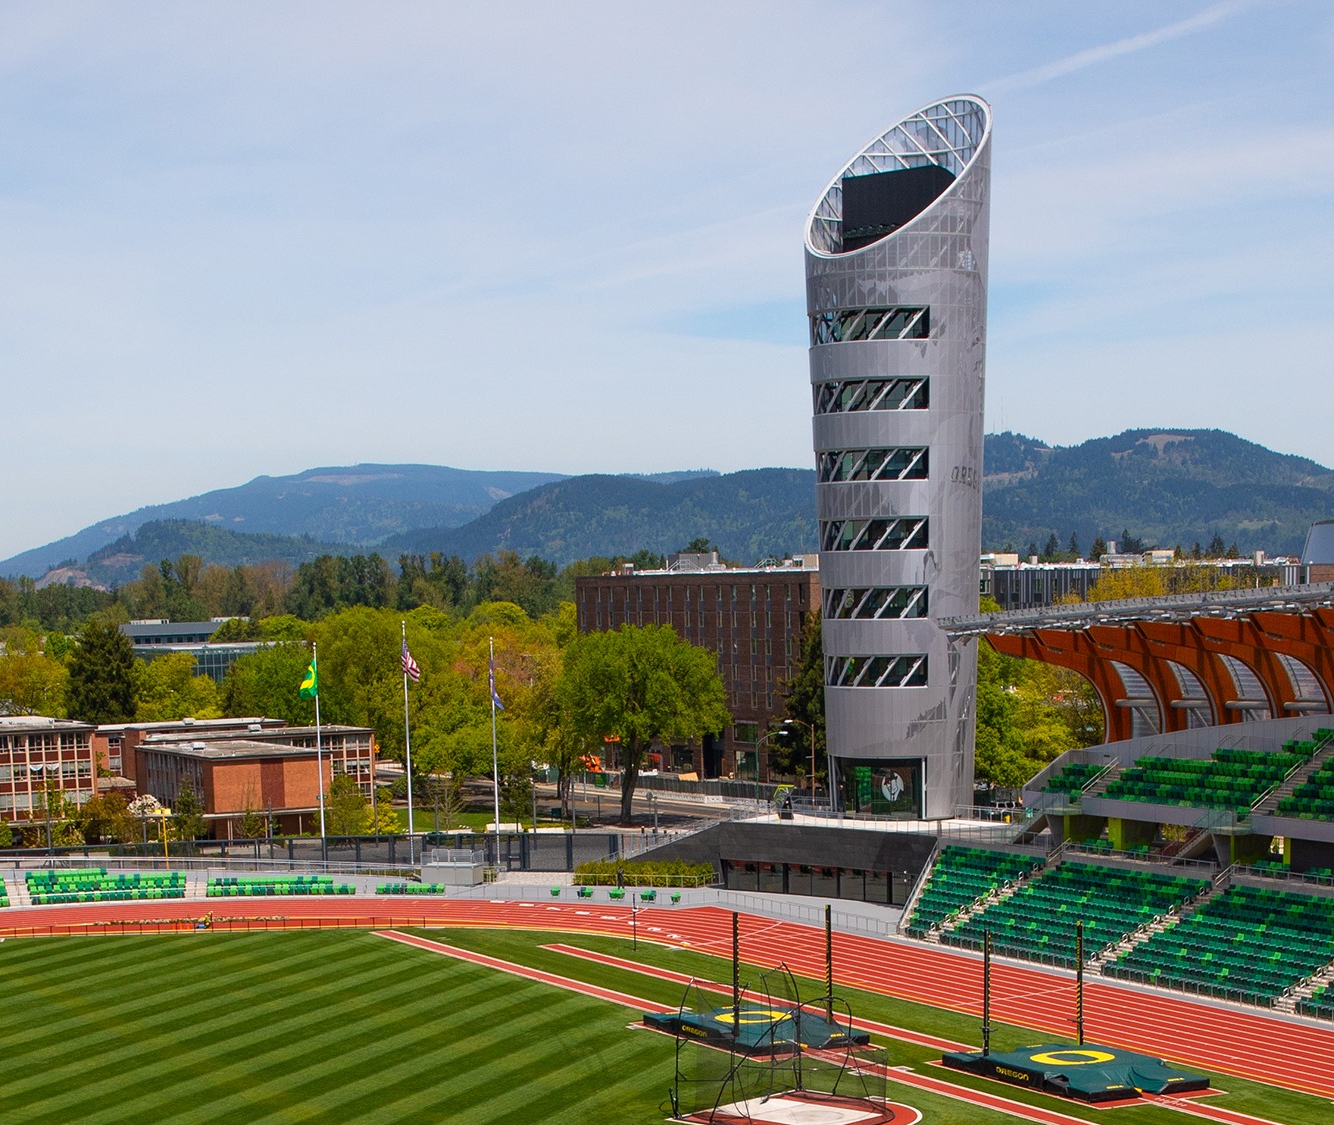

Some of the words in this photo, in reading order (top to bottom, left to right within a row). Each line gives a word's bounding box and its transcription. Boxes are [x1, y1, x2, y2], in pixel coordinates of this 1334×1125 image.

[682, 1024, 708, 1038] OREGON
[1031, 1050, 1115, 1065] O
[995, 1066, 1030, 1082] OREGON
